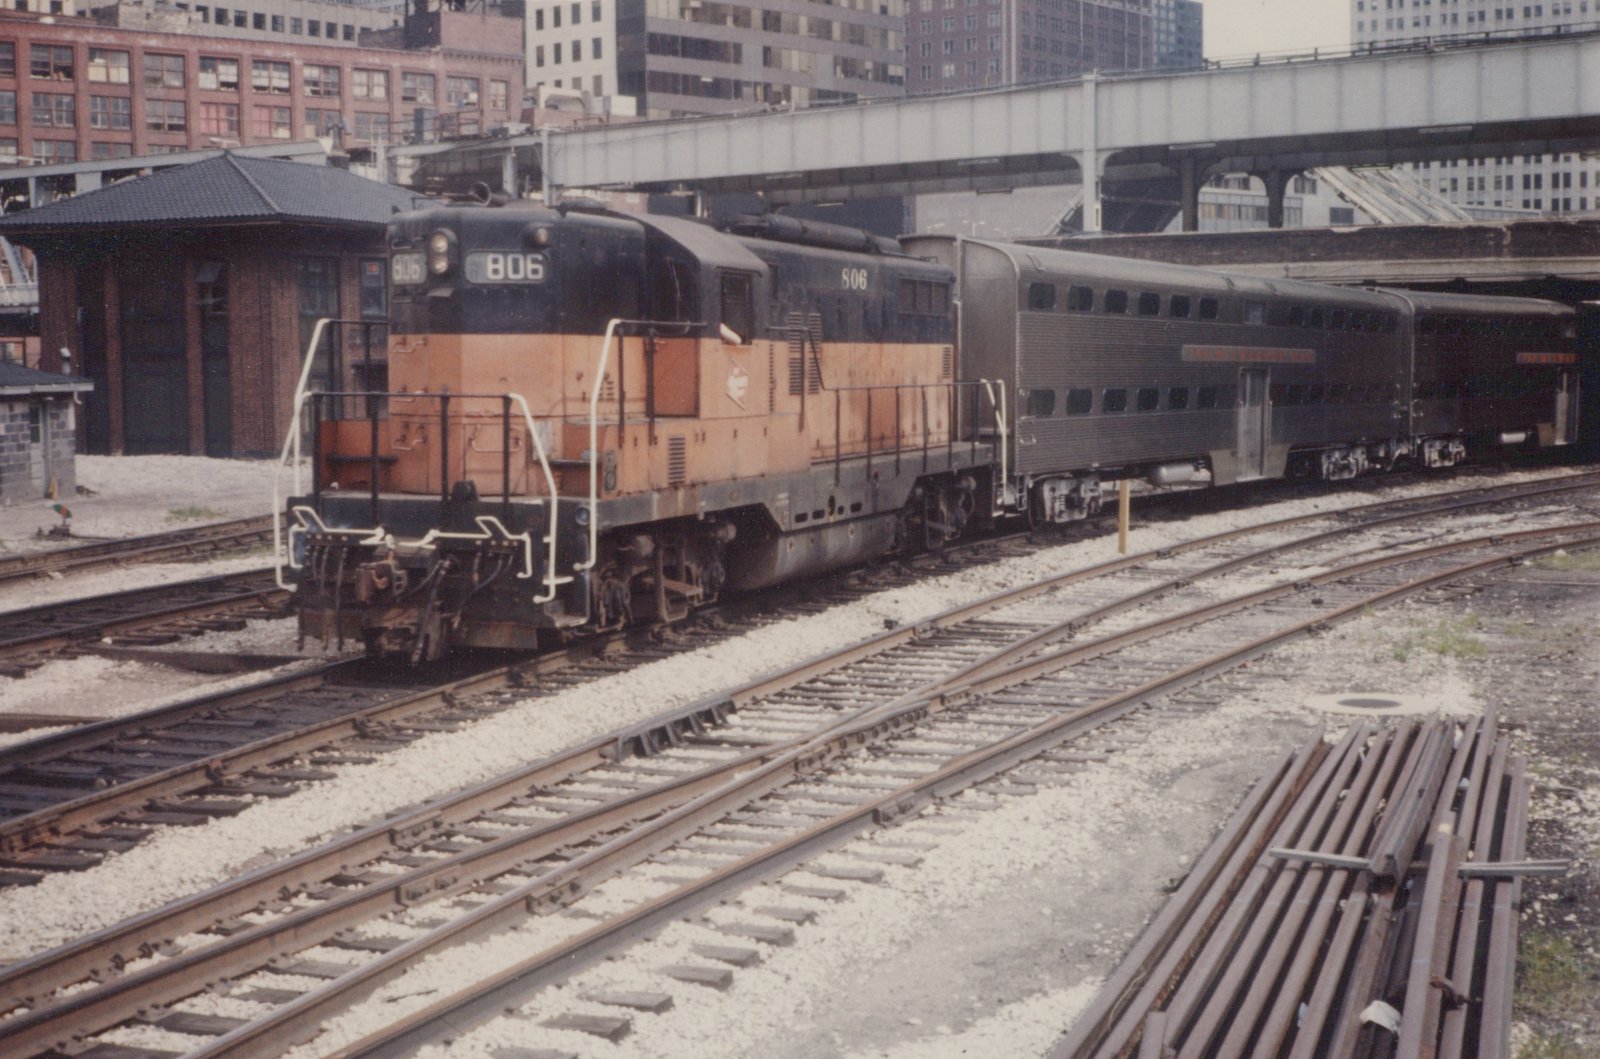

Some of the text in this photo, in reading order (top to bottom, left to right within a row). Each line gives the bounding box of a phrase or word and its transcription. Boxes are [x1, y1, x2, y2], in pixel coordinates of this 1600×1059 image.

[392, 253, 421, 280] 806
[487, 253, 545, 280] 806
[841, 267, 868, 290] 806
